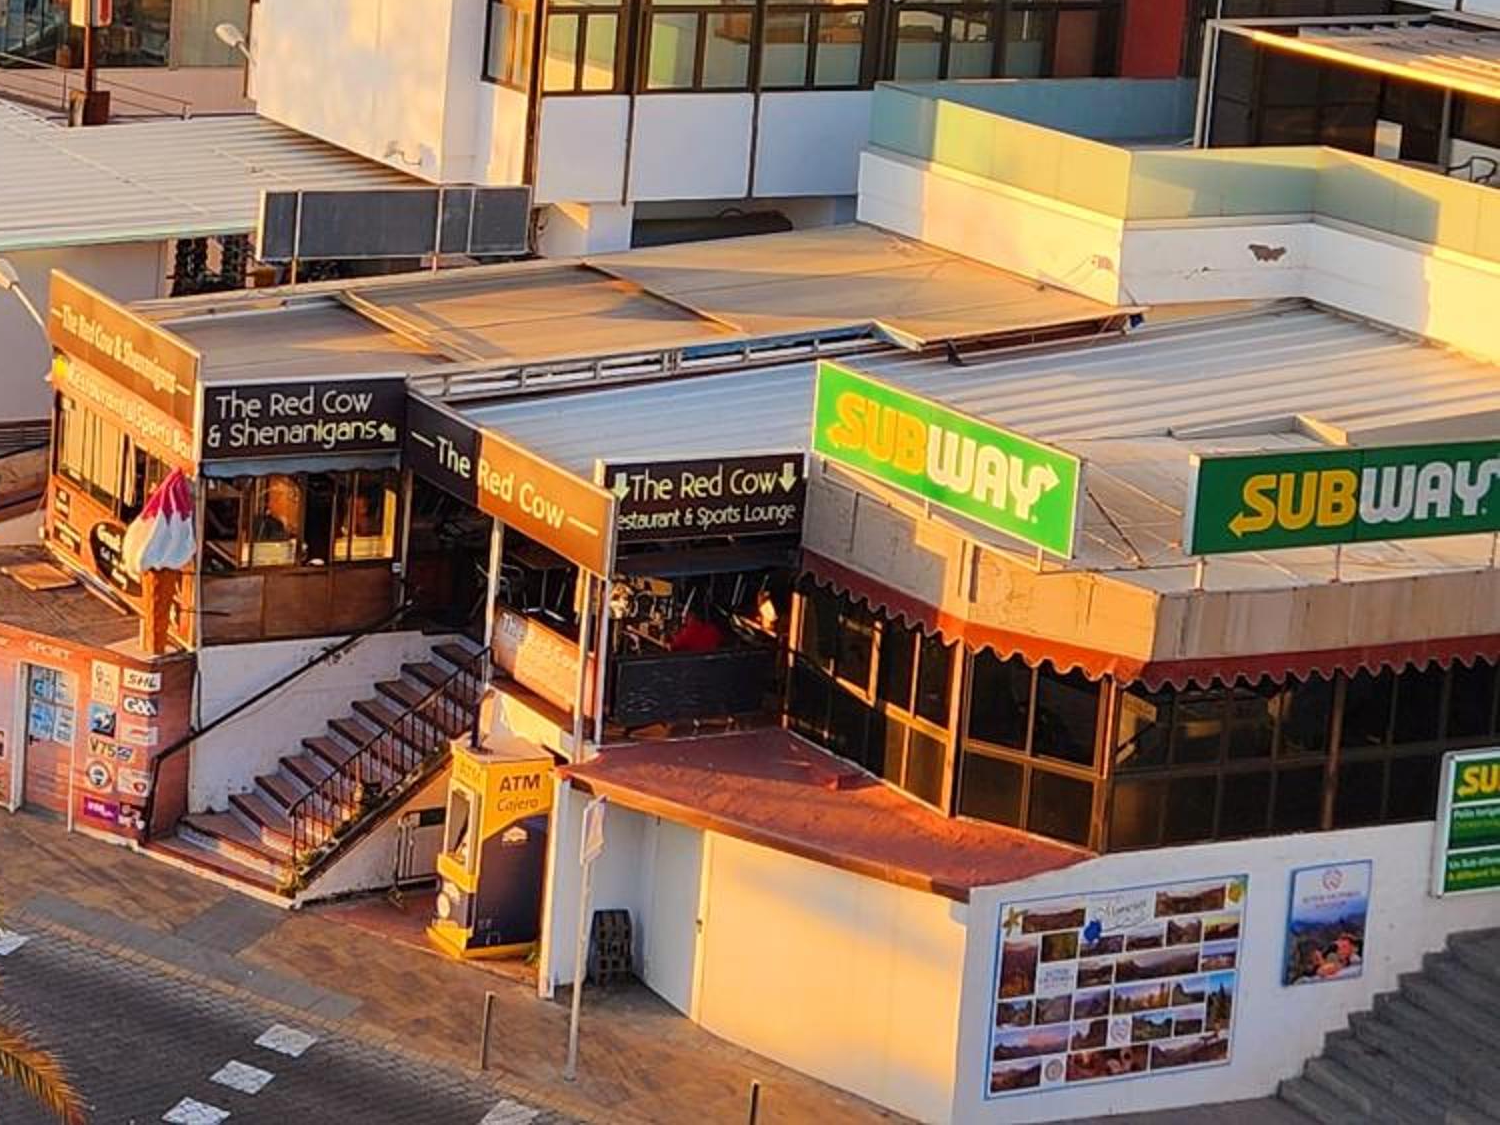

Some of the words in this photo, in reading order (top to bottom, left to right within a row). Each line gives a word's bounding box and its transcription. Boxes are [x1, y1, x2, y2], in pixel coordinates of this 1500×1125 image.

[62, 304, 79, 336] The
[78, 314, 96, 344] Red
[95, 323, 114, 356] Cow
[215, 387, 262, 419] The
[269, 387, 316, 418] Red
[321, 389, 374, 415] Cow
[206, 423, 222, 449] &
[228, 417, 379, 457] Shenanigans
[826, 391, 1060, 523] SUBWAY
[434, 434, 473, 480] The
[476, 458, 514, 503] Red
[517, 482, 566, 530] Cow
[628, 473, 674, 502] The
[679, 464, 723, 498] Red
[729, 470, 780, 496] Cow
[1227, 458, 1500, 538] SUBWAY
[615, 508, 681, 531] estaurant
[683, 504, 694, 526] &
[696, 504, 742, 534] Sports
[743, 502, 797, 530] Lounge
[499, 773, 541, 793] ATM
[497, 797, 539, 814] Cajero
